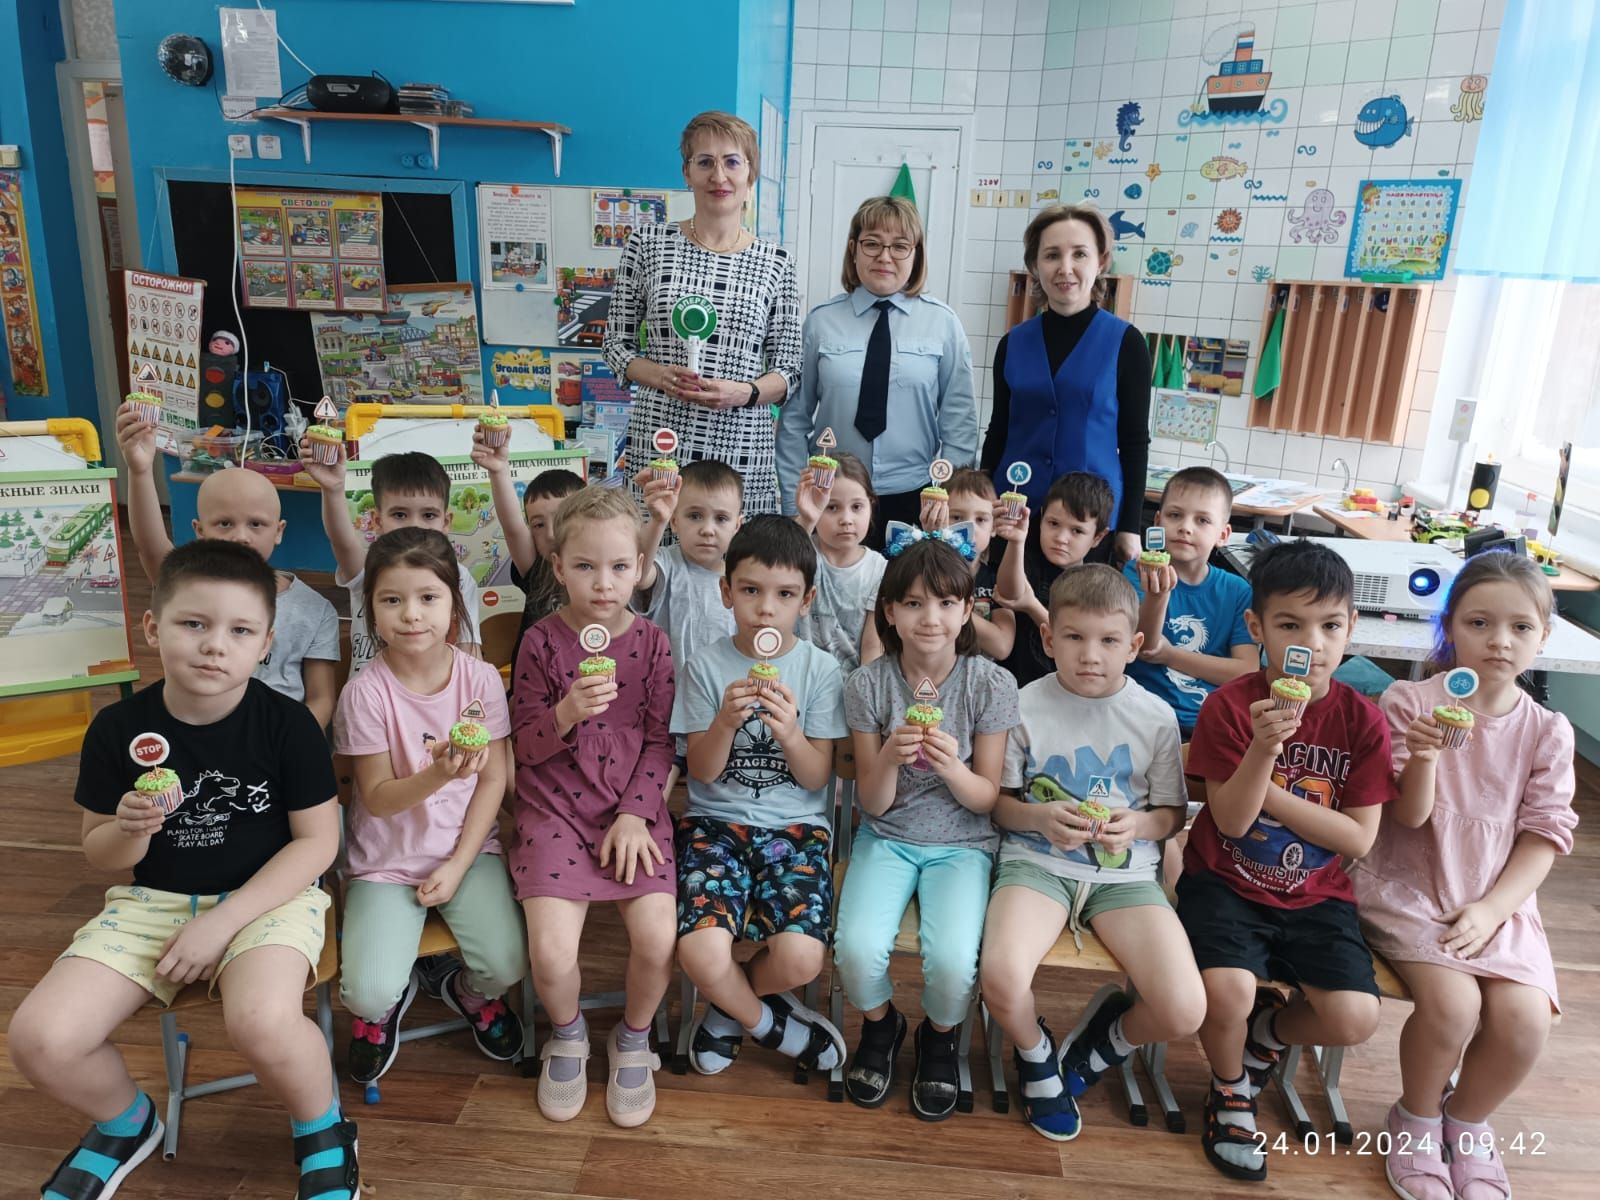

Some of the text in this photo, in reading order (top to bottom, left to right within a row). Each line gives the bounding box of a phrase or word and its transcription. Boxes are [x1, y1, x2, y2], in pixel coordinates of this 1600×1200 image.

[132, 274, 193, 293] ОСТОРОЖНО!
[495, 363, 530, 374] Уголок
[508, 456, 571, 470] РЕЩАЮЩИЕ
[49, 484, 101, 496] ЗНАКИ
[136, 743, 163, 757] STOP
[1275, 741, 1353, 788] ACING
[210, 837, 225, 846] DAY
